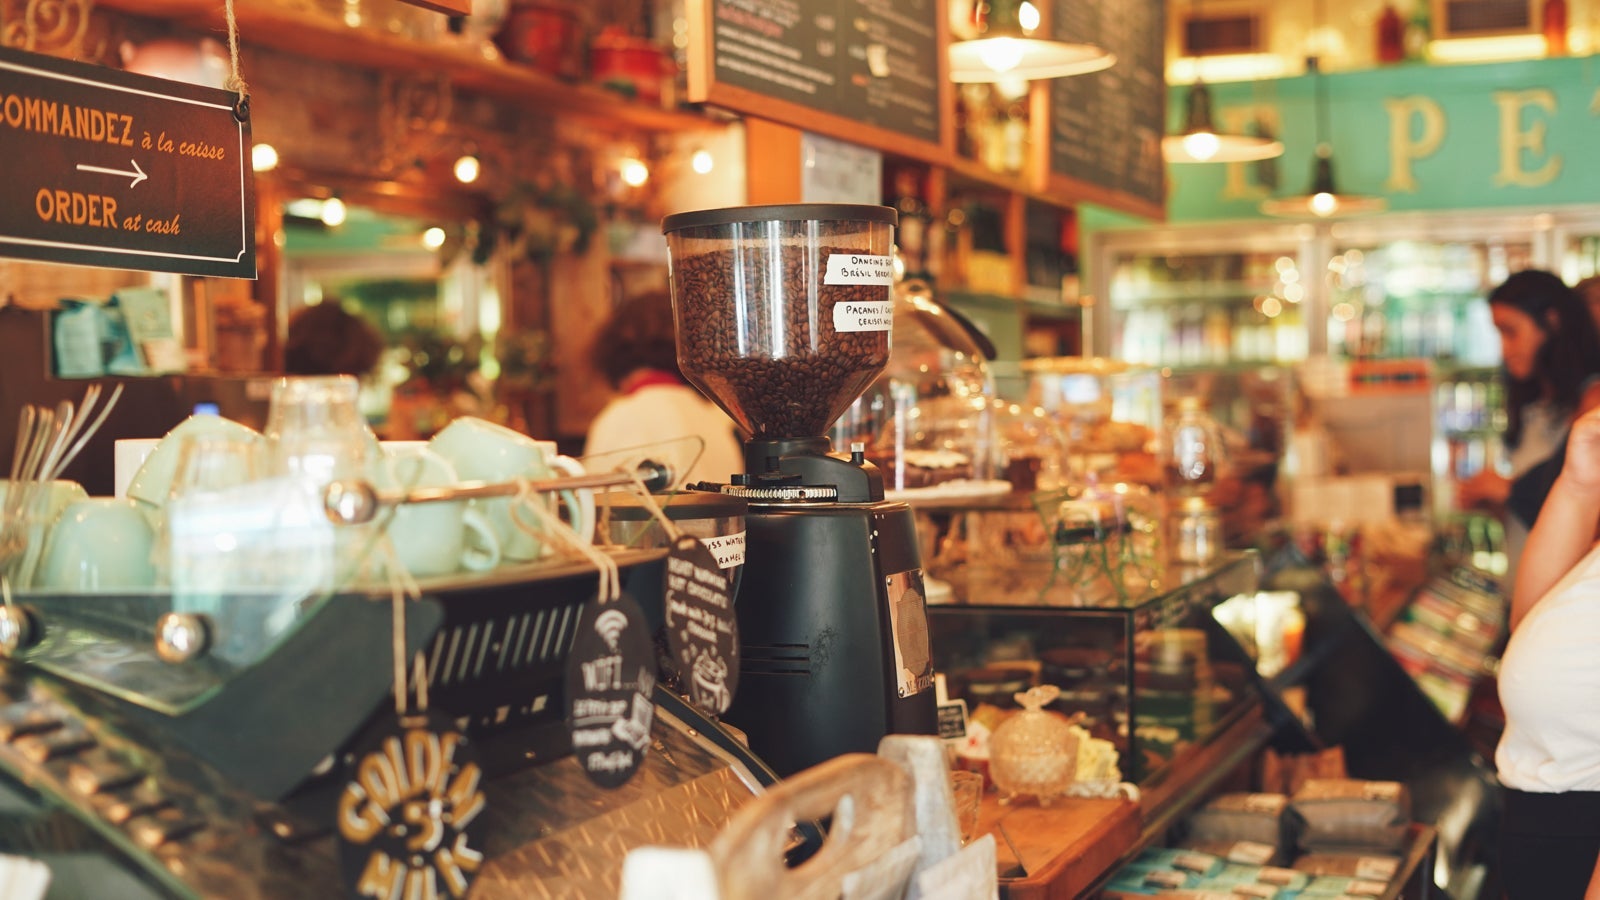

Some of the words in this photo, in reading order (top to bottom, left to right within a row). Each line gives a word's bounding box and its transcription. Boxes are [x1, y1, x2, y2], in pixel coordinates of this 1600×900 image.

[0, 93, 134, 147] OMMANDEZ
[141, 131, 153, 151] à
[157, 132, 175, 153] la
[179, 141, 225, 161] caisse
[35, 188, 118, 229] ORDER
[123, 214, 141, 232] at
[145, 214, 181, 236] cash
